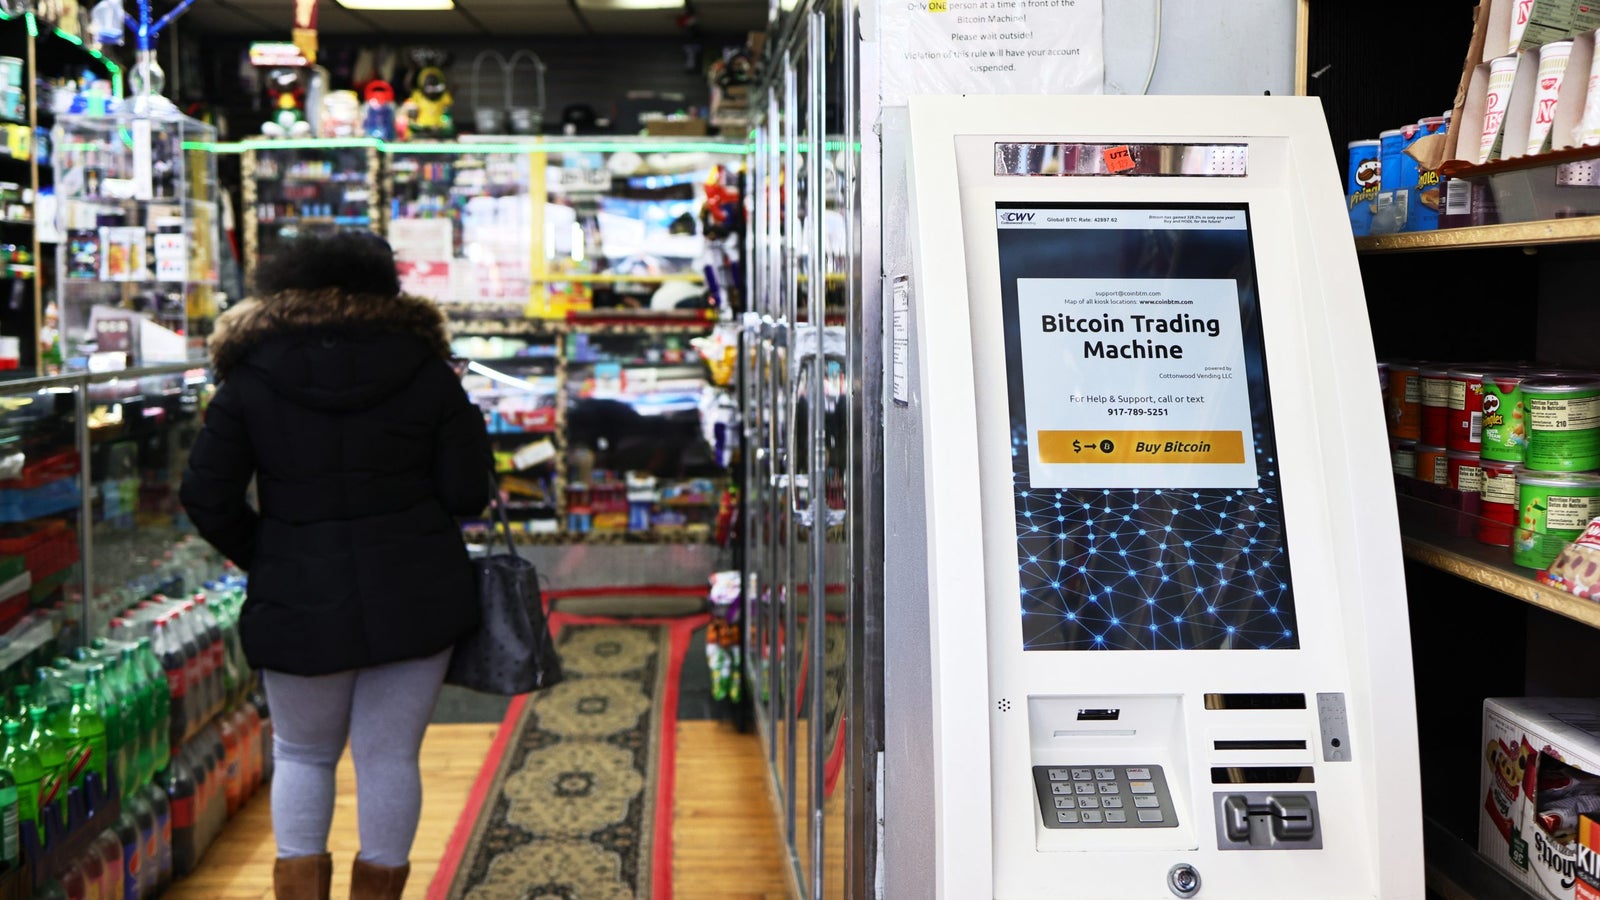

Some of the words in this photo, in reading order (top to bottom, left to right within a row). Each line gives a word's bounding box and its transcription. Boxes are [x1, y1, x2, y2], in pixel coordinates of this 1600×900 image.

[928, 1, 947, 11] ONE
[949, 2, 978, 12] person
[997, 0, 1016, 9] time
[1027, 0, 1049, 8] front
[957, 15, 986, 24] Bitcoin
[951, 33, 978, 42] Please
[980, 32, 998, 41] wait
[999, 31, 1033, 41] outside!
[904, 51, 941, 60] Violation
[971, 49, 987, 58] rule
[1005, 48, 1025, 58] have
[1027, 50, 1045, 59] your
[1046, 48, 1080, 57] account
[969, 63, 1016, 73] suspended.
[1007, 212, 1036, 222] CWV
[1041, 313, 1125, 333] Bitcoin
[1130, 313, 1220, 337] Trading
[1083, 339, 1183, 359] Machine
[1069, 395, 1085, 403] For
[1086, 395, 1107, 404] Help
[1109, 395, 1116, 403] &
[1117, 395, 1156, 404] Support,
[1157, 395, 1173, 403] call
[1186, 395, 1205, 403] text
[1107, 408, 1169, 416] 917-789-5251
[1135, 441, 1161, 455] Buy
[1164, 441, 1211, 453] Bitcoin
